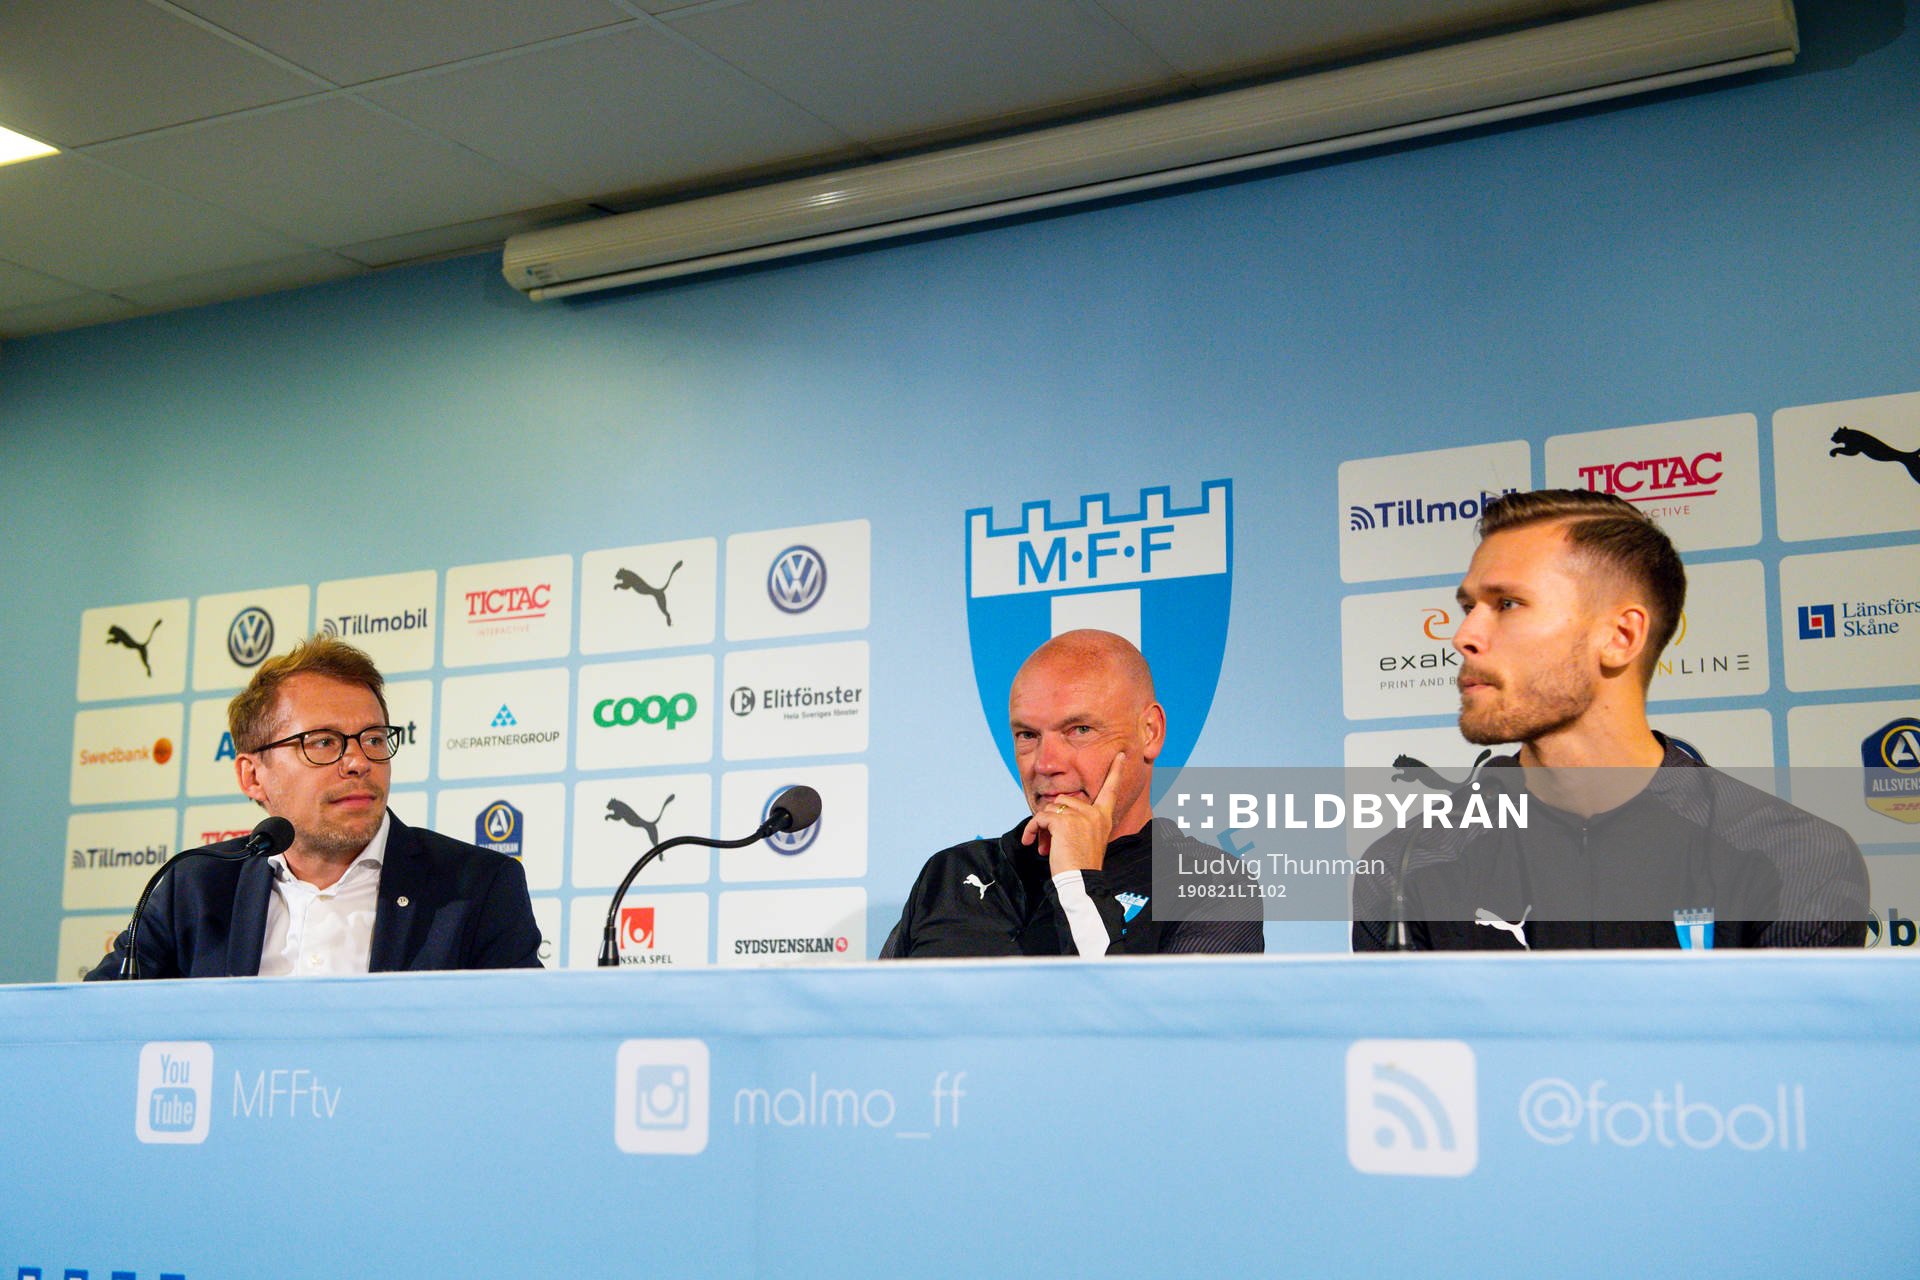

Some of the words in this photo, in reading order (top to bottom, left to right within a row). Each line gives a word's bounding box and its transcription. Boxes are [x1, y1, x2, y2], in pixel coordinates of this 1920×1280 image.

[1578, 451, 1723, 495] TICTAC
[465, 584, 551, 616] TICTAC
[338, 608, 427, 636] Tillmobil
[1843, 618, 1900, 637] Skåne
[1379, 647, 1459, 671] exak
[1380, 680, 1415, 690] PRINT
[1420, 678, 1445, 687] AND
[763, 686, 862, 709] Elitfönster
[593, 692, 698, 731] coop
[80, 747, 149, 766] Swedbank
[1872, 778, 1920, 792] ALLSVEN
[87, 845, 167, 868] Tillmobil
[620, 955, 646, 964] NSKA
[649, 954, 672, 964] SPEL
[735, 938, 835, 954] SYDSVENSKAN
[160, 1054, 190, 1084] You
[232, 1069, 341, 1119] MFFtv
[734, 1071, 967, 1139] malmo_ff
[154, 1093, 194, 1125] Tube
[1519, 1077, 1807, 1151] @fotboll
